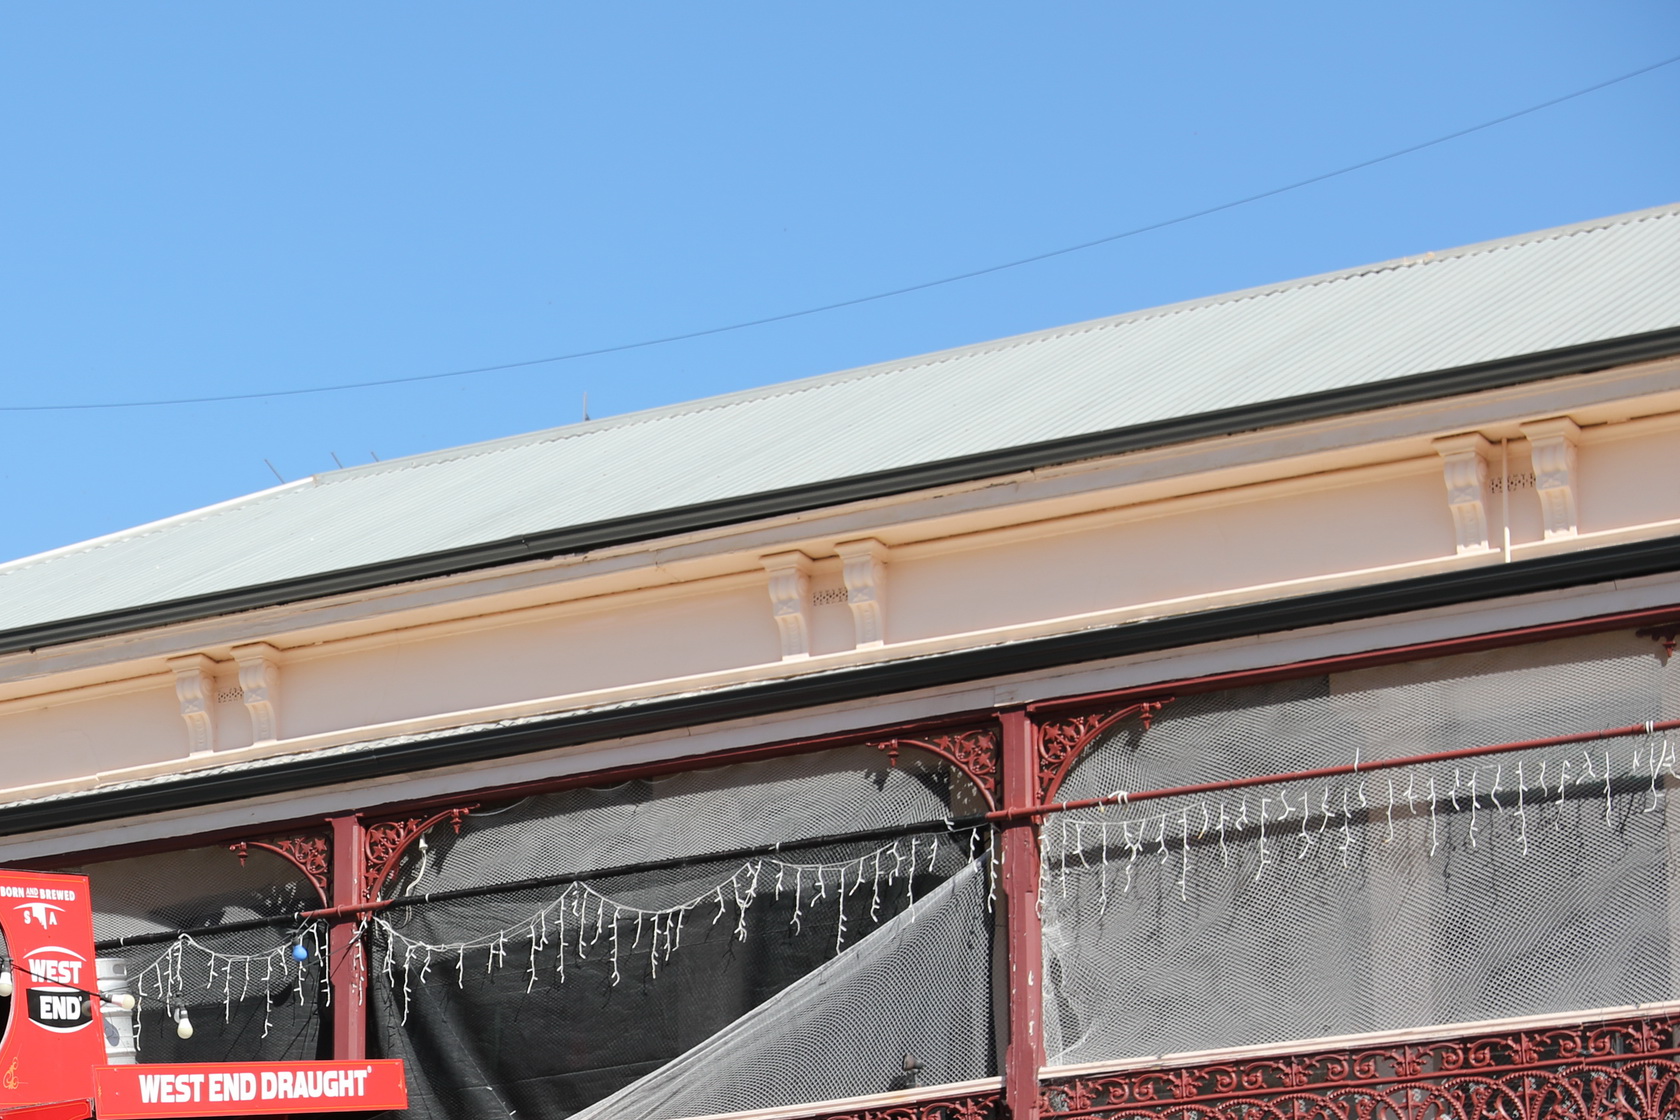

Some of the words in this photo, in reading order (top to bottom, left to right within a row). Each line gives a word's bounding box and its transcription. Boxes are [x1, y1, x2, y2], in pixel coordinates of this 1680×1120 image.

[0, 886, 24, 898] BORN
[26, 887, 38, 896] AND
[40, 889, 75, 901] BREWED
[23, 910, 31, 924] S
[49, 912, 57, 925] A
[28, 959, 82, 984] WEST
[39, 995, 81, 1020] END
[139, 1074, 204, 1103] WEST
[209, 1072, 257, 1102] END
[261, 1069, 367, 1099] DRAUGHT
